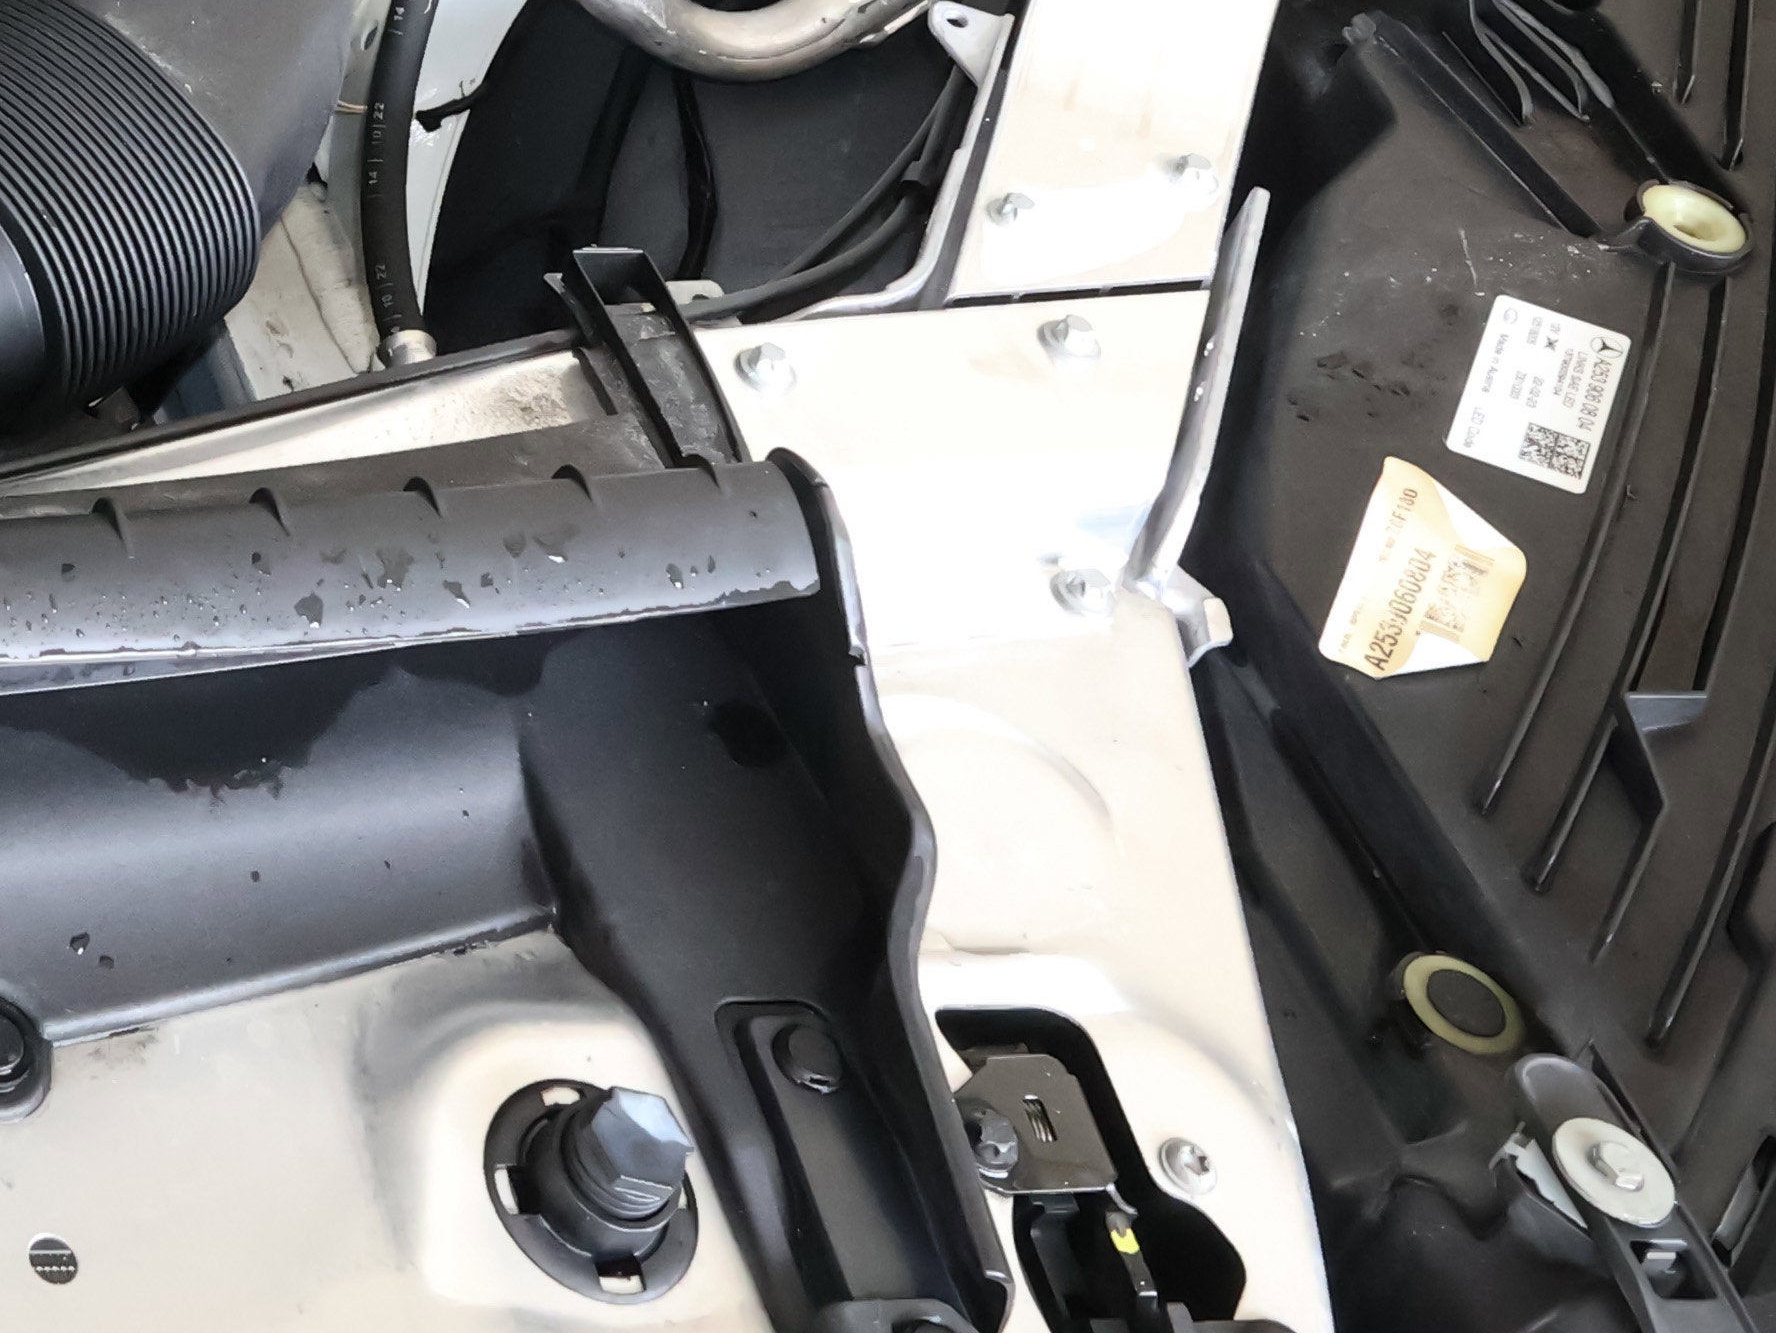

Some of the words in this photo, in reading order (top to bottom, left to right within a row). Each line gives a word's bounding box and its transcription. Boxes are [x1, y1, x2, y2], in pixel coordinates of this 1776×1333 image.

[373, 102, 385, 120] 22
[1495, 334, 1509, 354] Made
[1482, 366, 1498, 393] Austria
[1590, 357, 1612, 385] A253
[1569, 374, 1581, 391] SAE
[1563, 391, 1576, 409] LED
[1585, 382, 1604, 403] 906
[1471, 407, 1486, 425] LED
[1580, 402, 1598, 418] 08
[1577, 418, 1595, 432] 04
[1463, 426, 1480, 448] Code
